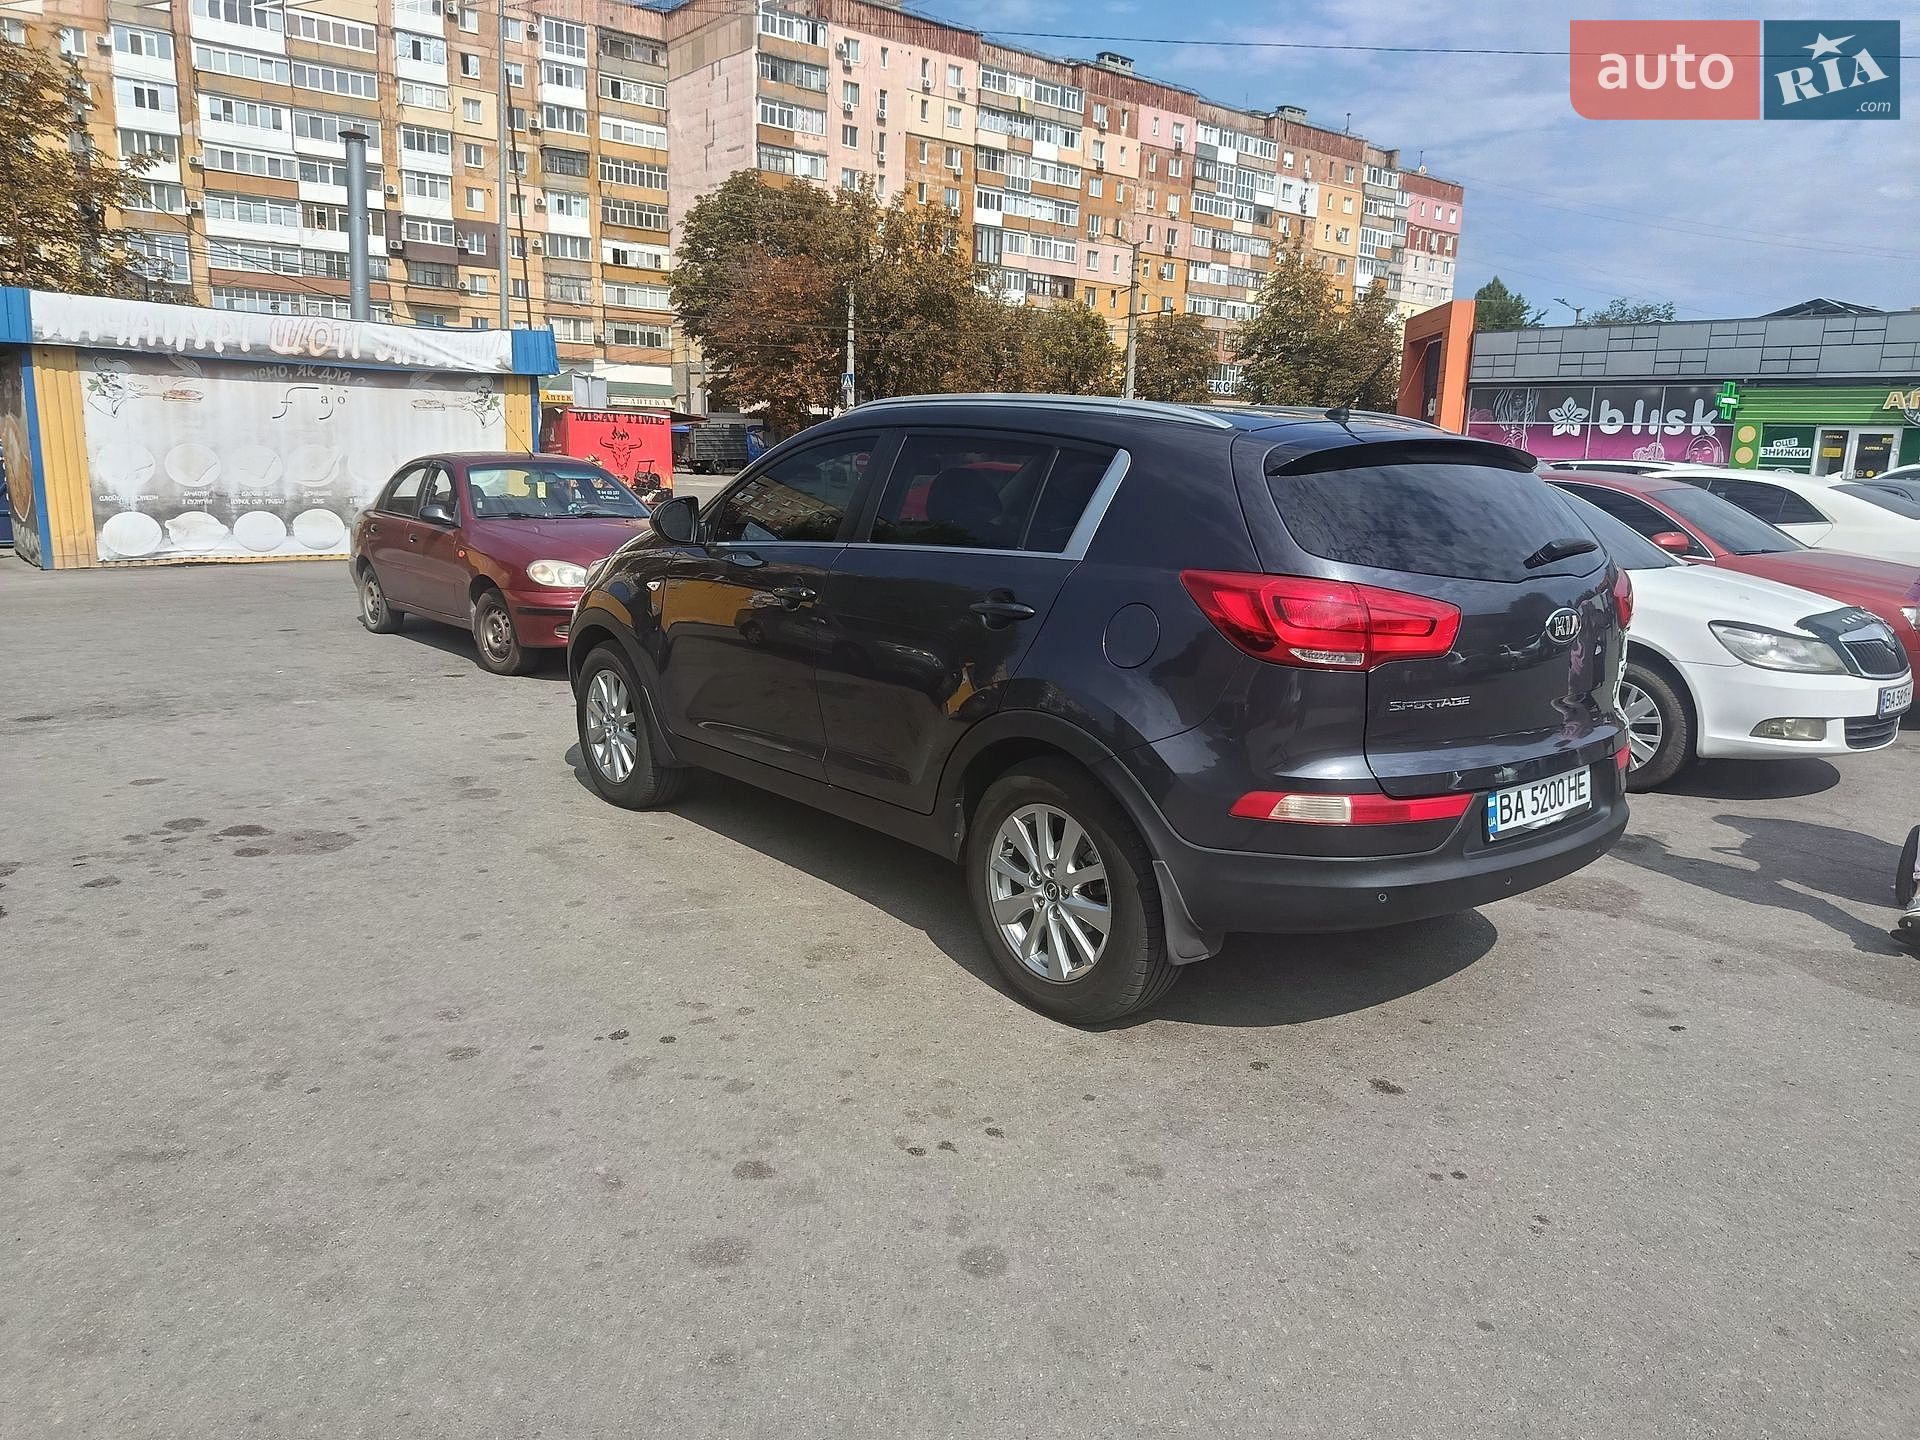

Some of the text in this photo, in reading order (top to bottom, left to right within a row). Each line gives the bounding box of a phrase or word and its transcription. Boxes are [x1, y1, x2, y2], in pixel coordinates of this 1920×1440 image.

[575, 412, 665, 426] MEAT TIME
[1599, 398, 1719, 436] blisk
[1761, 448, 1809, 457] ЗНИЖКИ
[1555, 615, 1581, 637] KIA
[1389, 696, 1471, 712] SPORTAGE
[1500, 770, 1587, 825] BA 5200 HE
